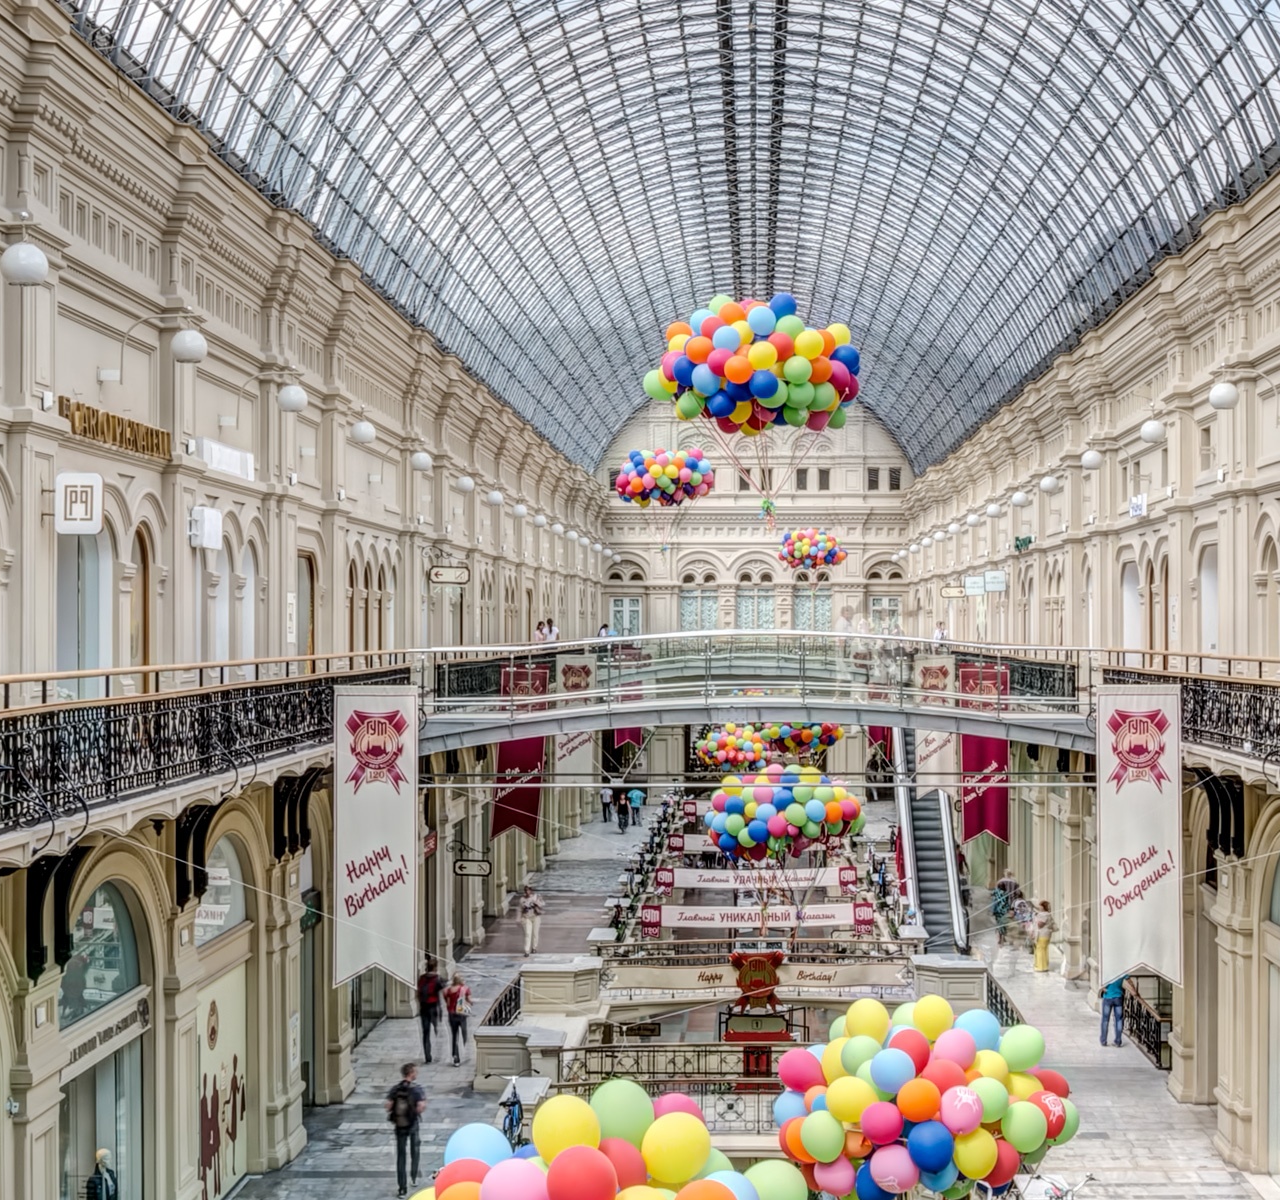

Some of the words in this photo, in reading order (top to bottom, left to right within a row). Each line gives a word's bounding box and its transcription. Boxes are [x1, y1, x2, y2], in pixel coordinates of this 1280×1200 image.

[70, 401, 113, 444] CARLO
[368, 770, 386, 780] 120
[1130, 769, 1148, 779] 120
[345, 844, 393, 884] Happy
[1106, 866, 1120, 887] С
[1120, 844, 1158, 879] Днем
[343, 853, 410, 918] Birthday!
[697, 874, 730, 884] Главный
[1103, 849, 1177, 918] Рождения!
[676, 911, 715, 922] Главный
[719, 910, 791, 924] УНИКАЛНЫЙ
[697, 970, 724, 983] Happy
[796, 970, 838, 983] Birthday!
